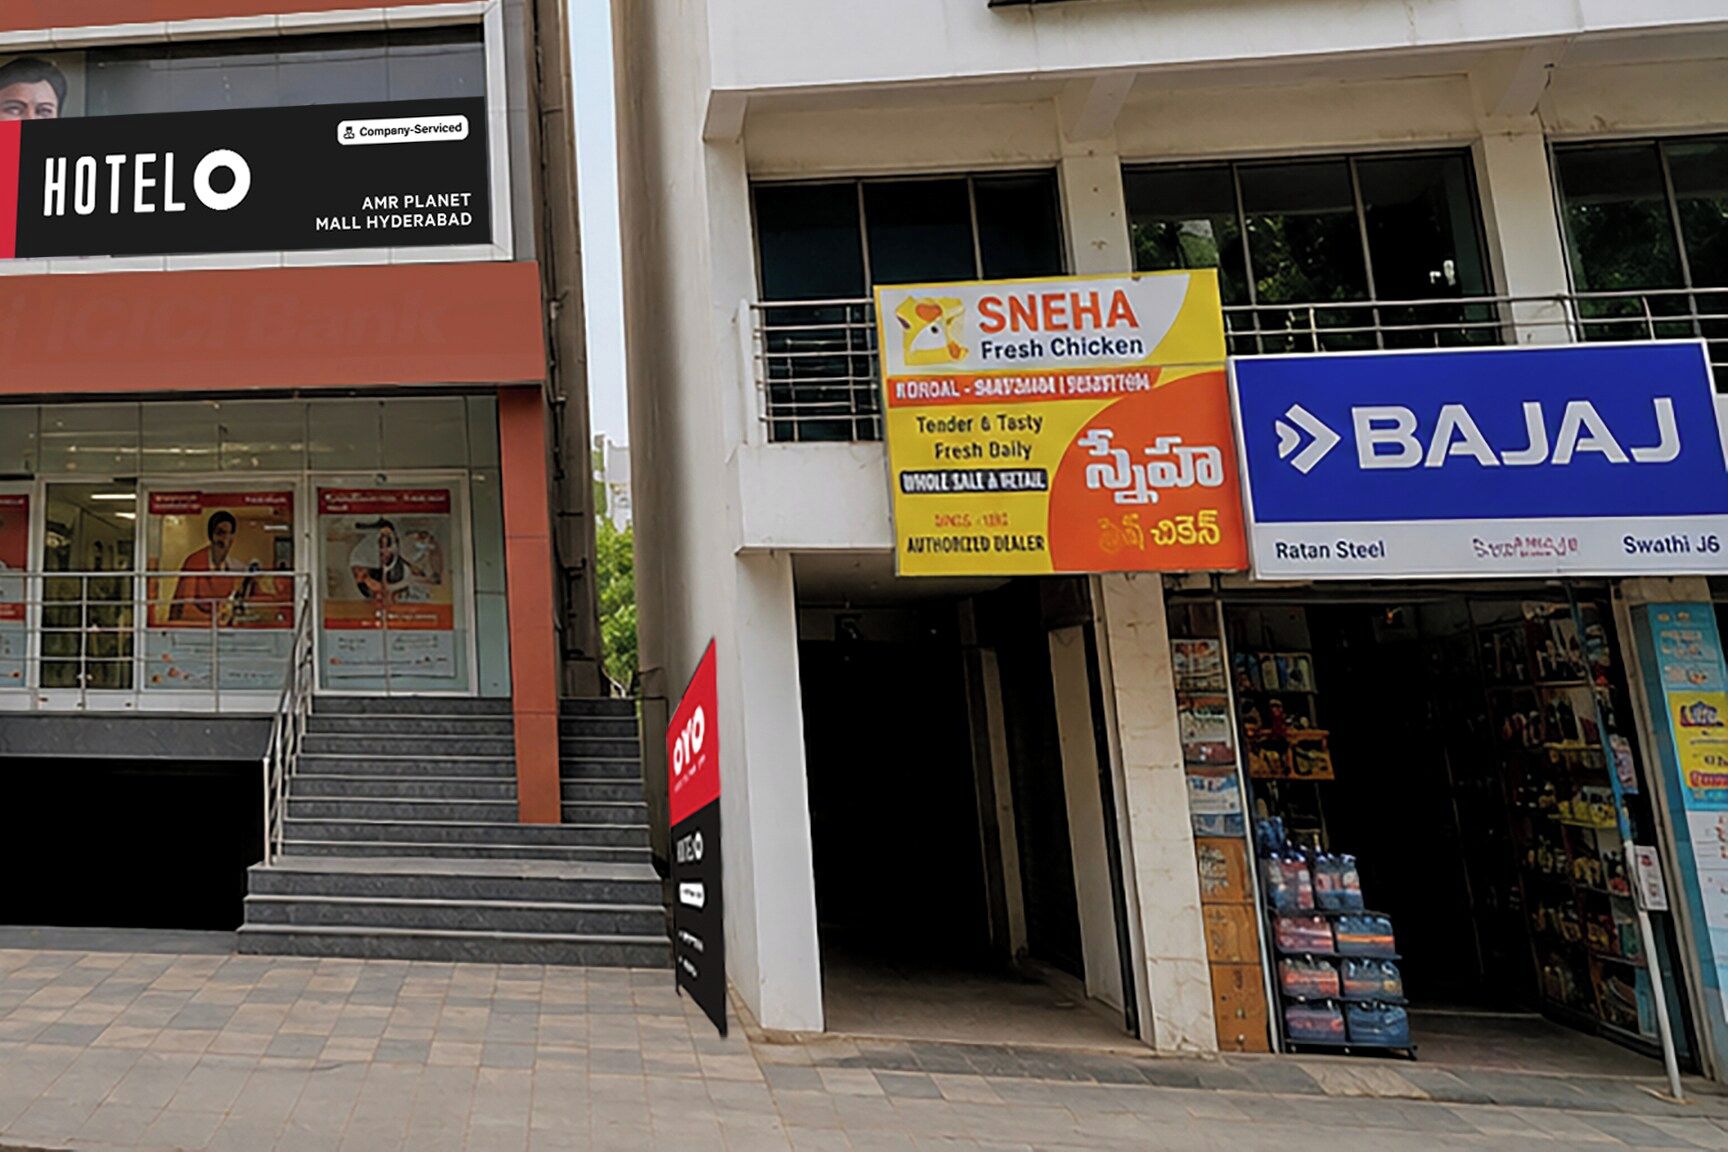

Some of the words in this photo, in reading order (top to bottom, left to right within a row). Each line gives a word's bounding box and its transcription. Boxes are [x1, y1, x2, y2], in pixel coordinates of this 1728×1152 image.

[359, 122, 462, 138] Company-Serviced
[43, 152, 186, 217] HOTEL
[361, 196, 399, 210] AMR
[404, 193, 471, 209] PLANET
[315, 216, 361, 230] MALL
[366, 212, 472, 229] HYDERABAD
[977, 289, 1139, 334] SNEHA
[981, 337, 1043, 360] Fresh
[1050, 336, 1144, 357] Chicken
[916, 415, 973, 434] Tender
[996, 413, 1043, 435] Tasty
[1351, 397, 1682, 470] BAJAJ
[934, 442, 978, 460] Fresh
[988, 440, 1032, 461] Daily
[1275, 541, 1331, 560] Ratan
[1335, 539, 1385, 559] Steel
[1623, 535, 1692, 554] Swathi
[673, 705, 705, 776] OYO
